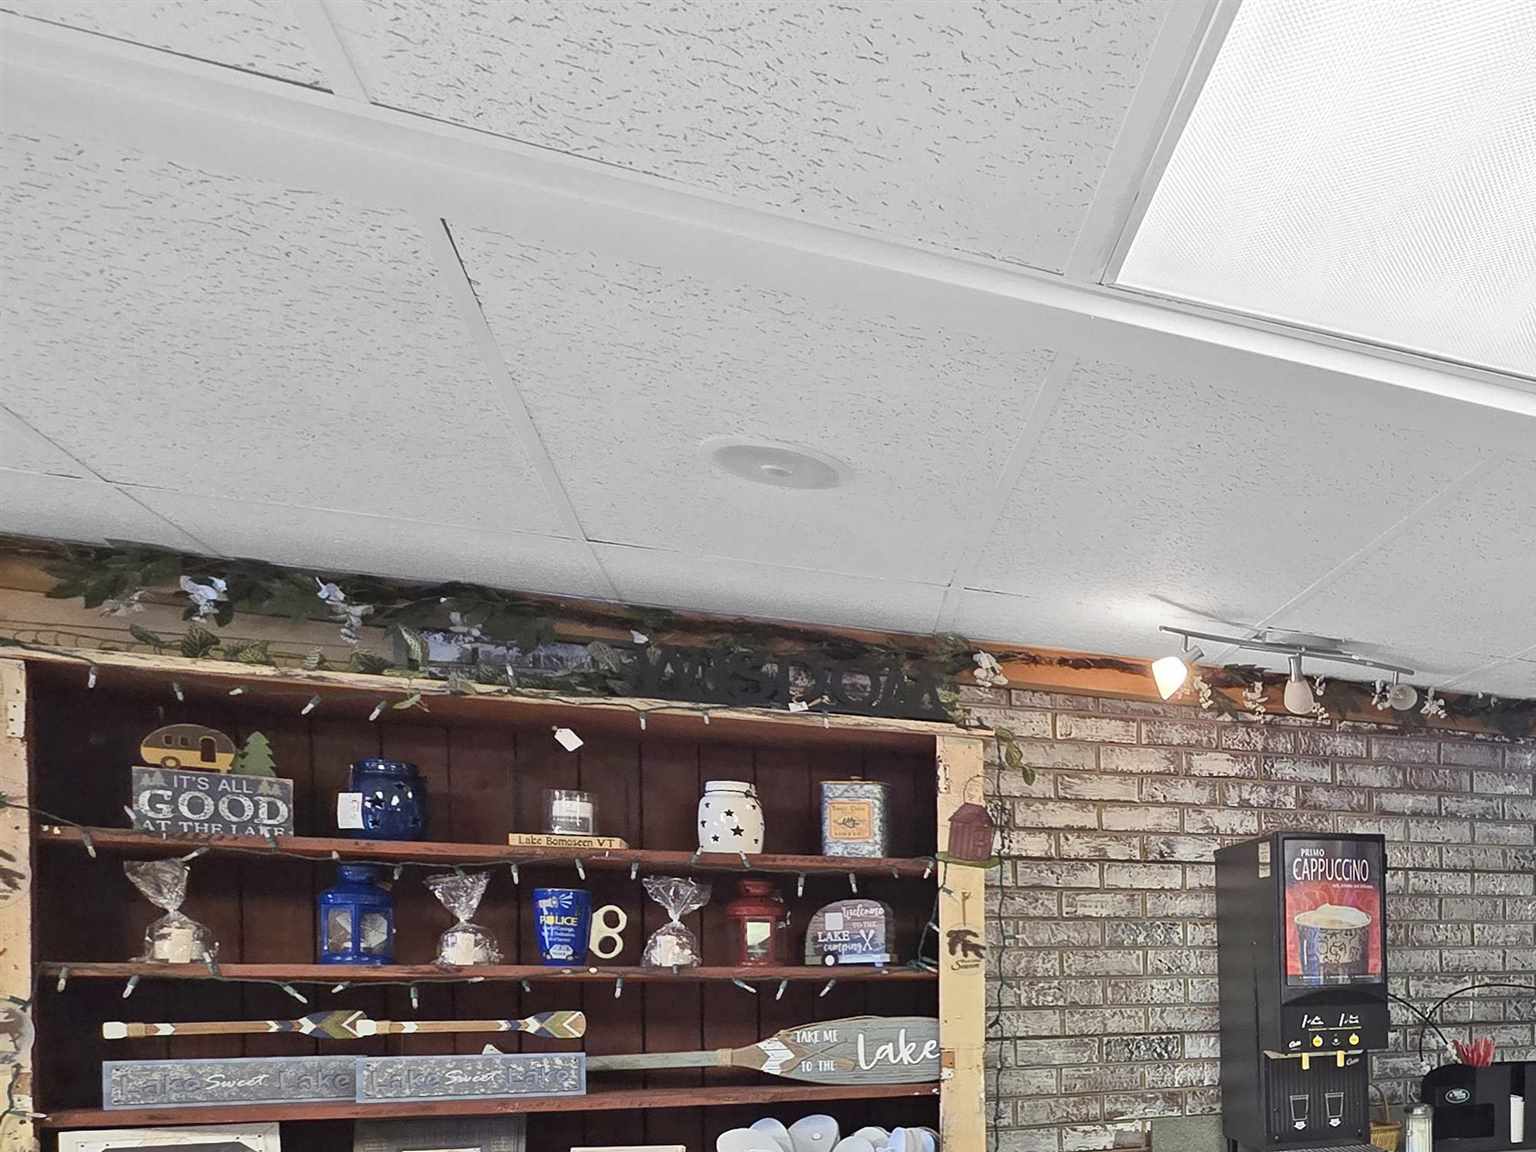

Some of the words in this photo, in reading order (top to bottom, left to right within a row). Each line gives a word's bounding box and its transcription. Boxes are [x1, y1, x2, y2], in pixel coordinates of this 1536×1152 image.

[173, 775, 209, 790] IT'S
[218, 779, 253, 793] ALL
[138, 789, 289, 825] GOOD
[143, 820, 171, 832] AT
[178, 821, 223, 834] THE
[518, 835, 542, 845] Lake
[1300, 848, 1325, 857] PRIMO
[817, 931, 850, 942] LAKE
[823, 941, 862, 958] camping
[795, 1031, 821, 1043] TAKE
[824, 1030, 839, 1043] ME
[801, 1061, 812, 1072] TO
[818, 1060, 835, 1072] THE
[204, 1073, 269, 1091] Sweet
[444, 1069, 499, 1086] Sweet
